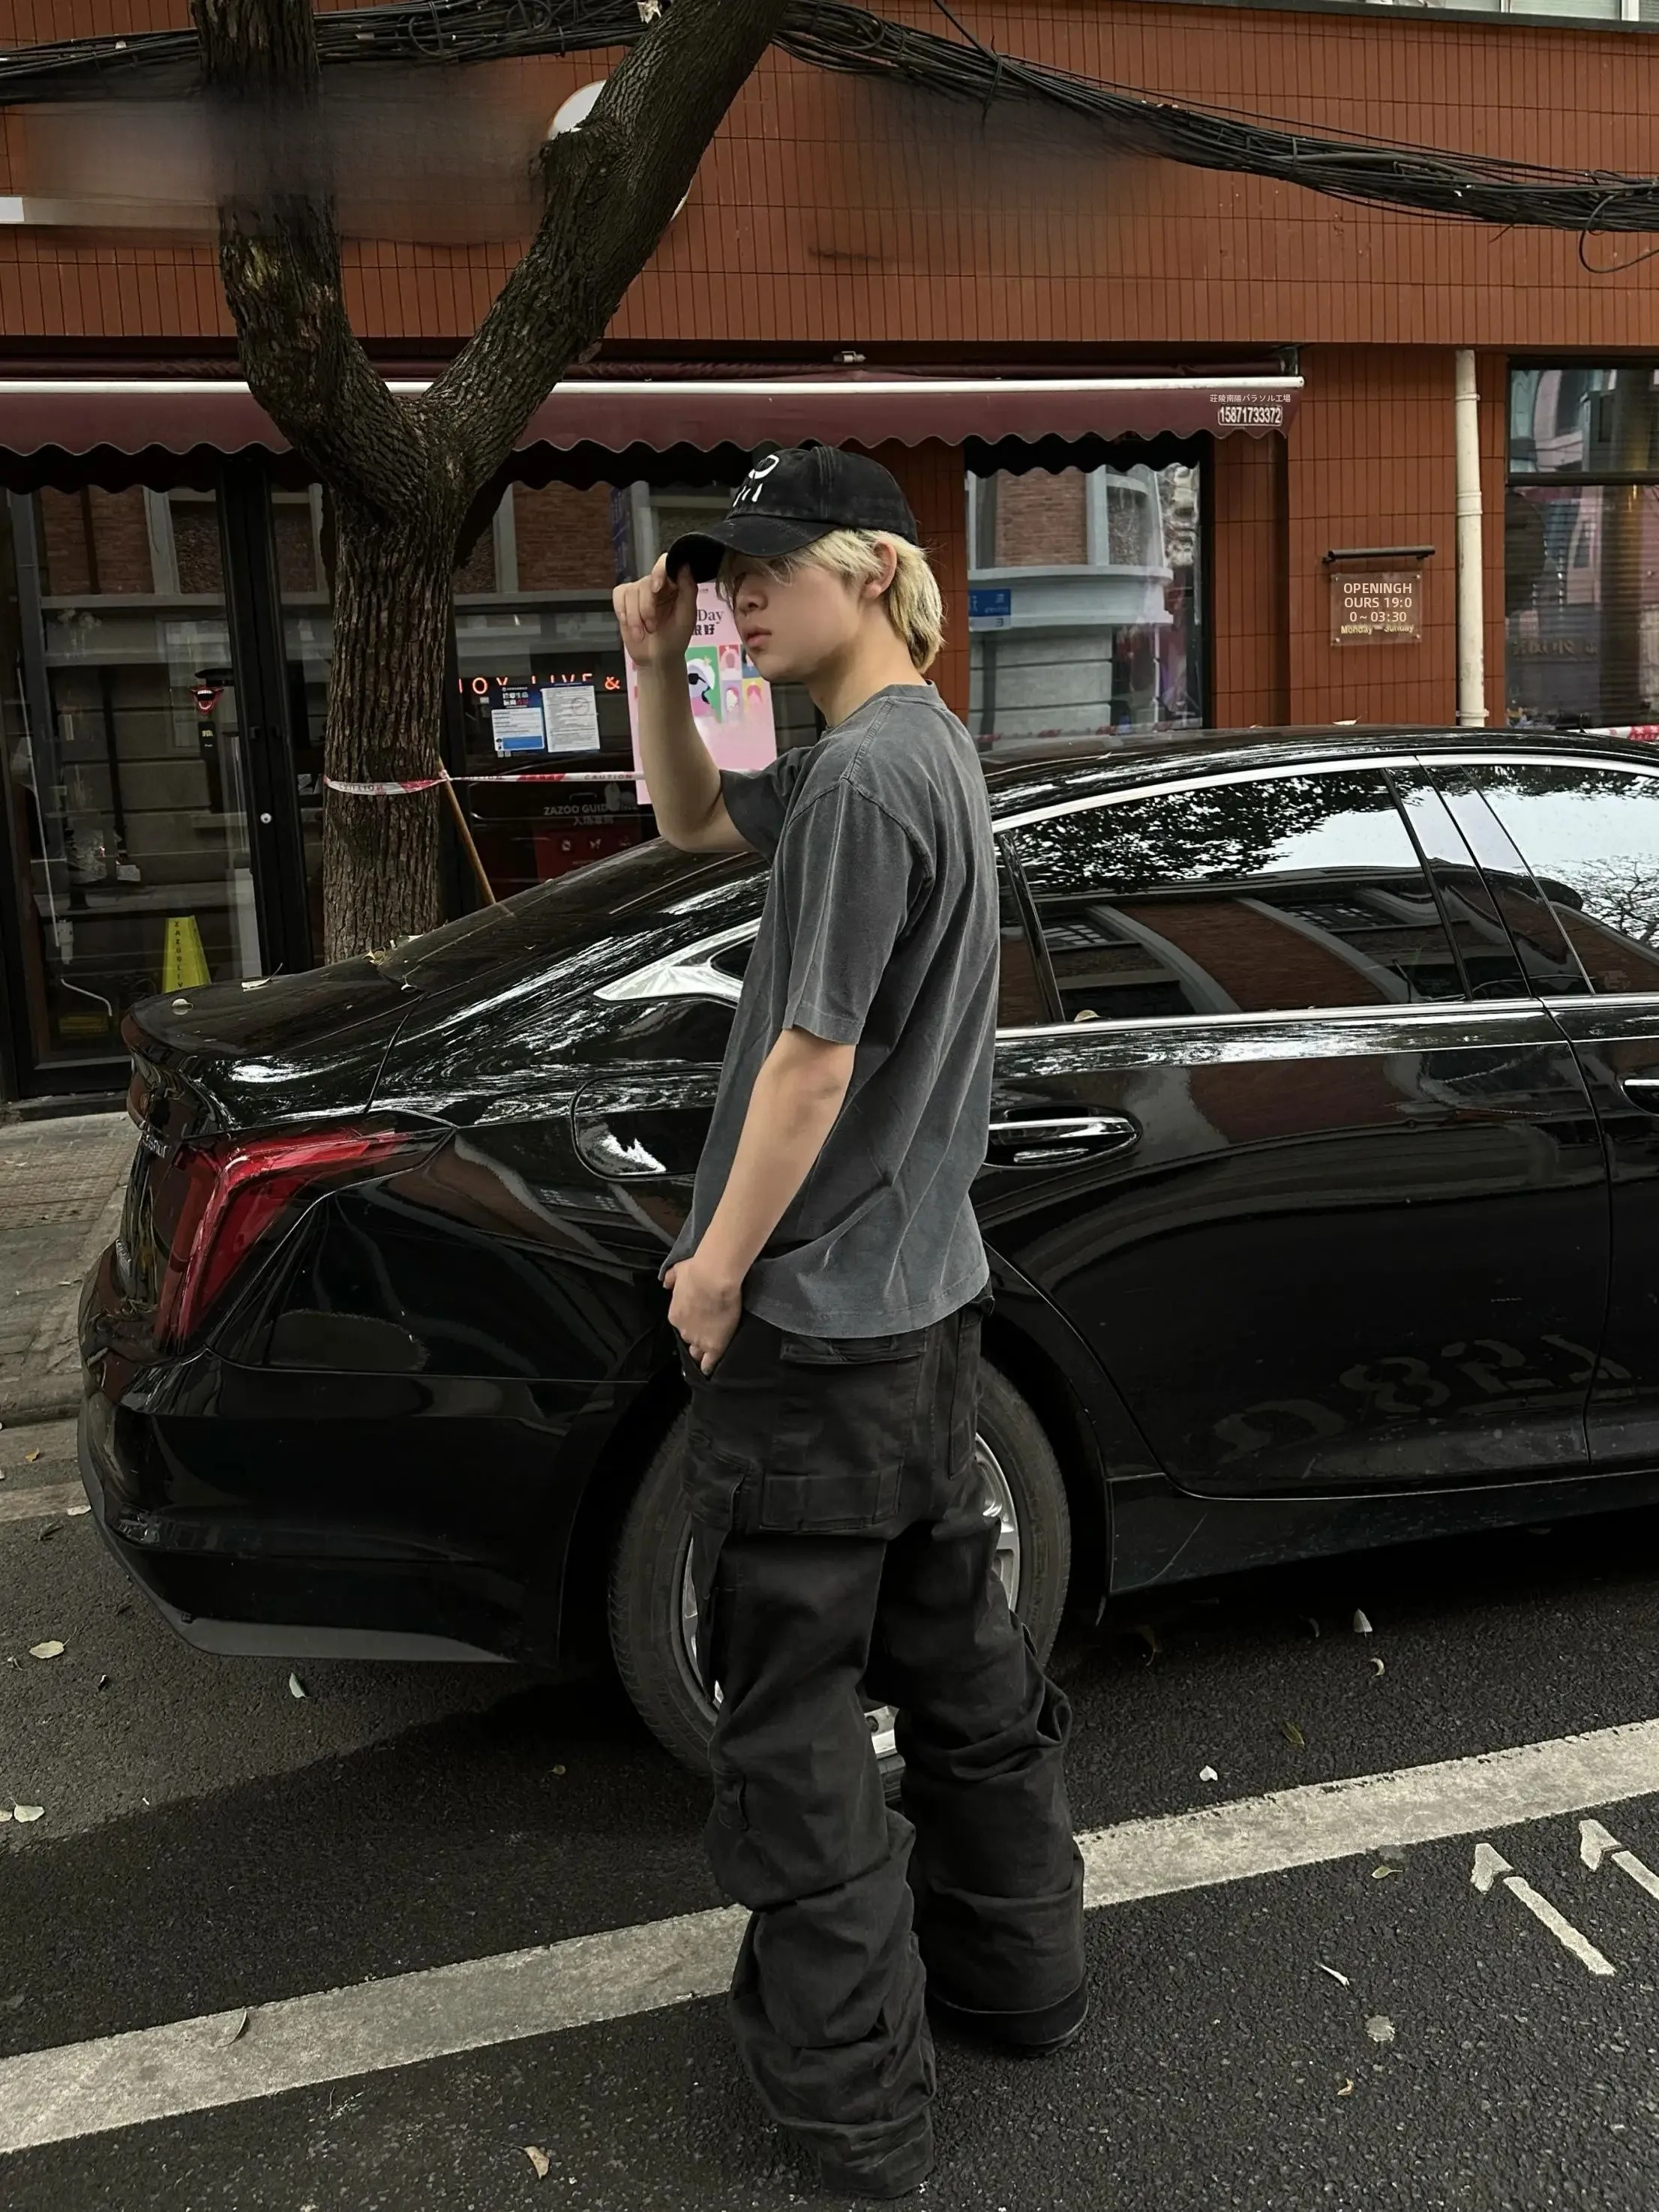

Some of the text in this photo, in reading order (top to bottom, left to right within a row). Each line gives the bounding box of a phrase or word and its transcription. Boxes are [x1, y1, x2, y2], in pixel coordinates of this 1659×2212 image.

[1220, 406, 1281, 424] 15871733372
[1344, 583, 1412, 593] OPENINGH
[1345, 597, 1412, 608] OURS 19:0
[698, 609, 724, 624] Day
[1370, 611, 1407, 622] 03:30
[543, 805, 580, 815] ZAZOO
